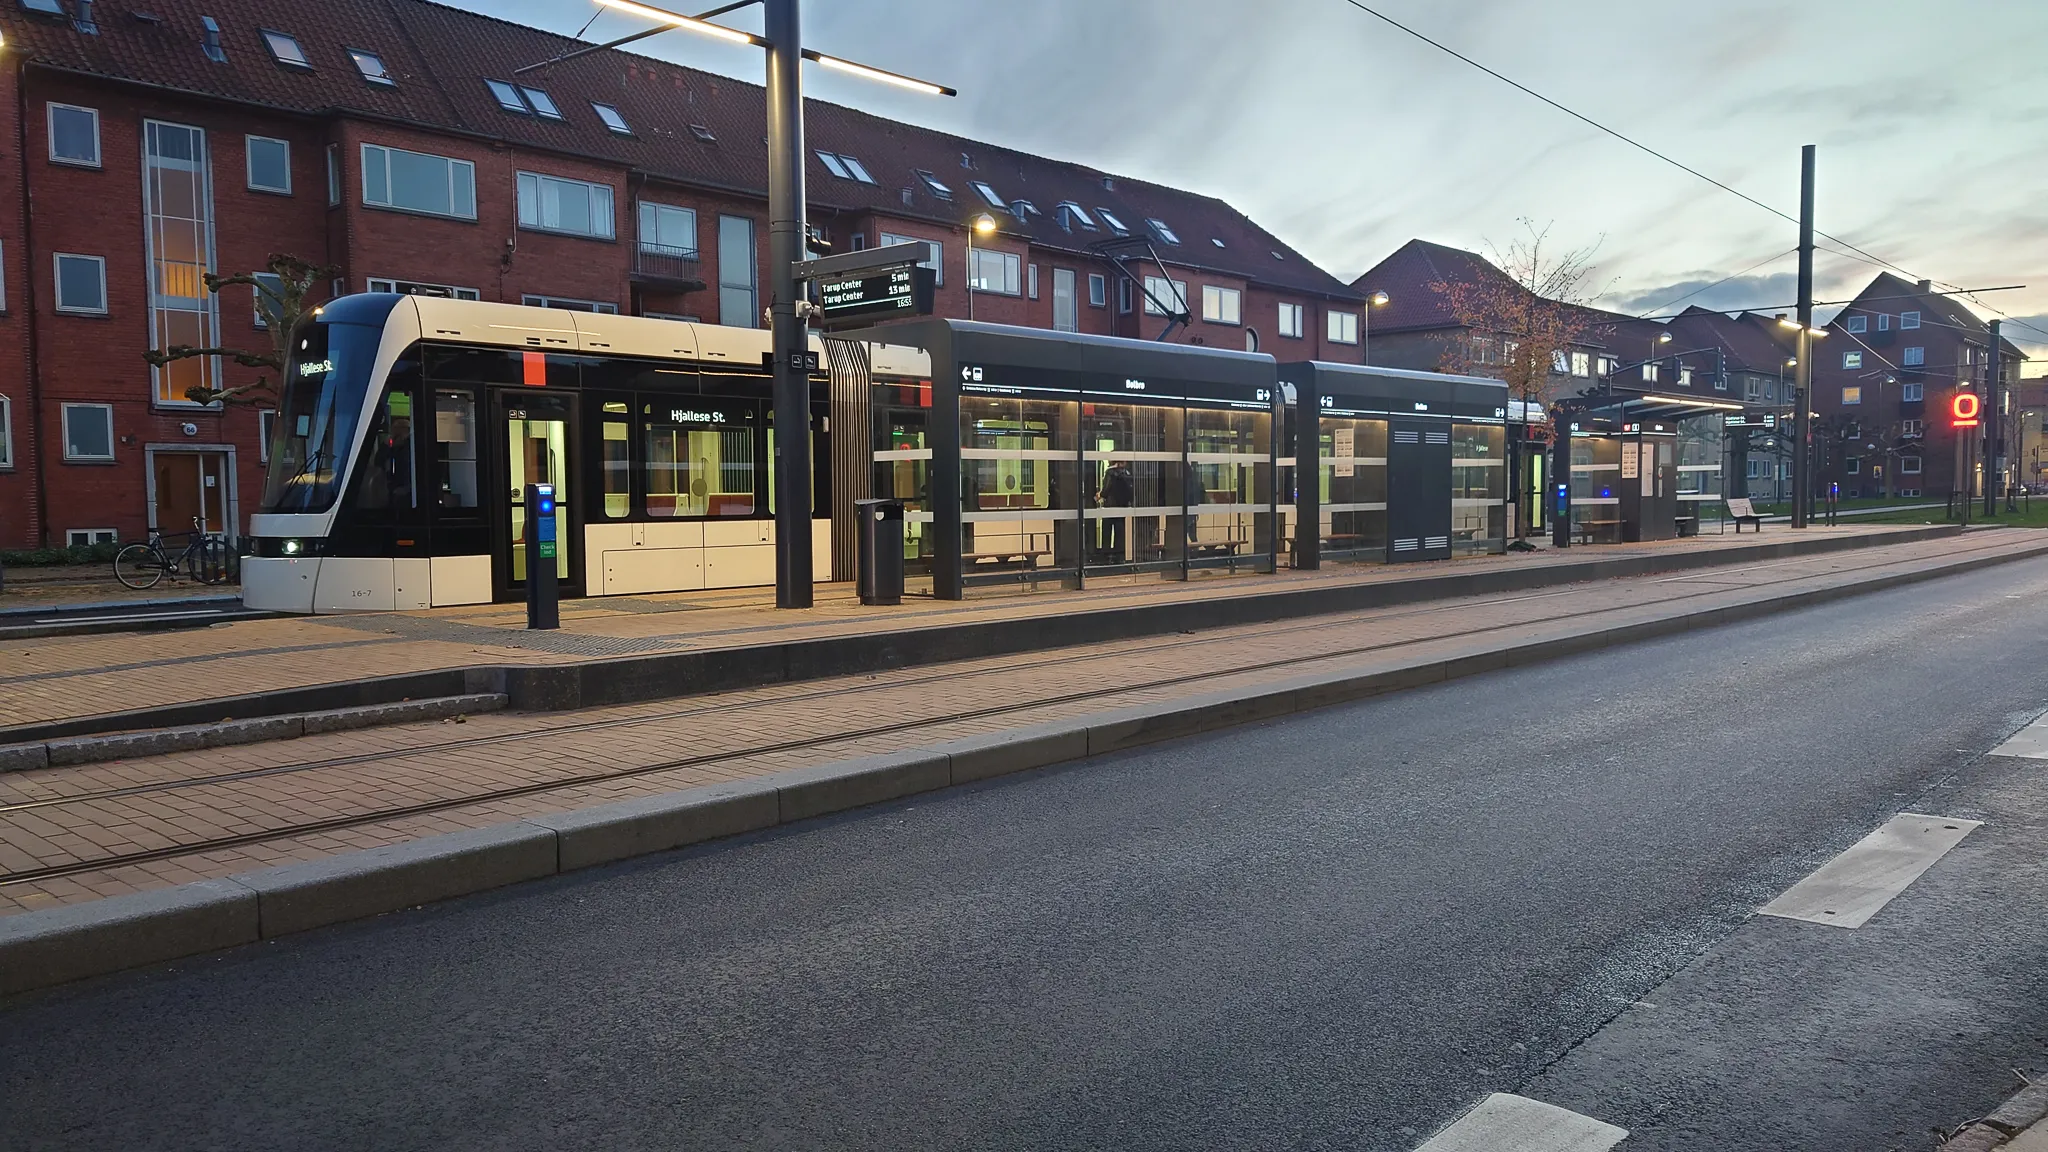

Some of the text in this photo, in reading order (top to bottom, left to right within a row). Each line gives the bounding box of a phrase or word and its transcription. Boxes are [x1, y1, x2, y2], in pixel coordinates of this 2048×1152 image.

[822, 271, 910, 294] Tarup Center 5 min
[823, 283, 911, 305] Tarup Center 13 min
[300, 362, 324, 377] Hjallese
[671, 409, 726, 423] Hjallese St.
[351, 589, 372, 597] 16-7
